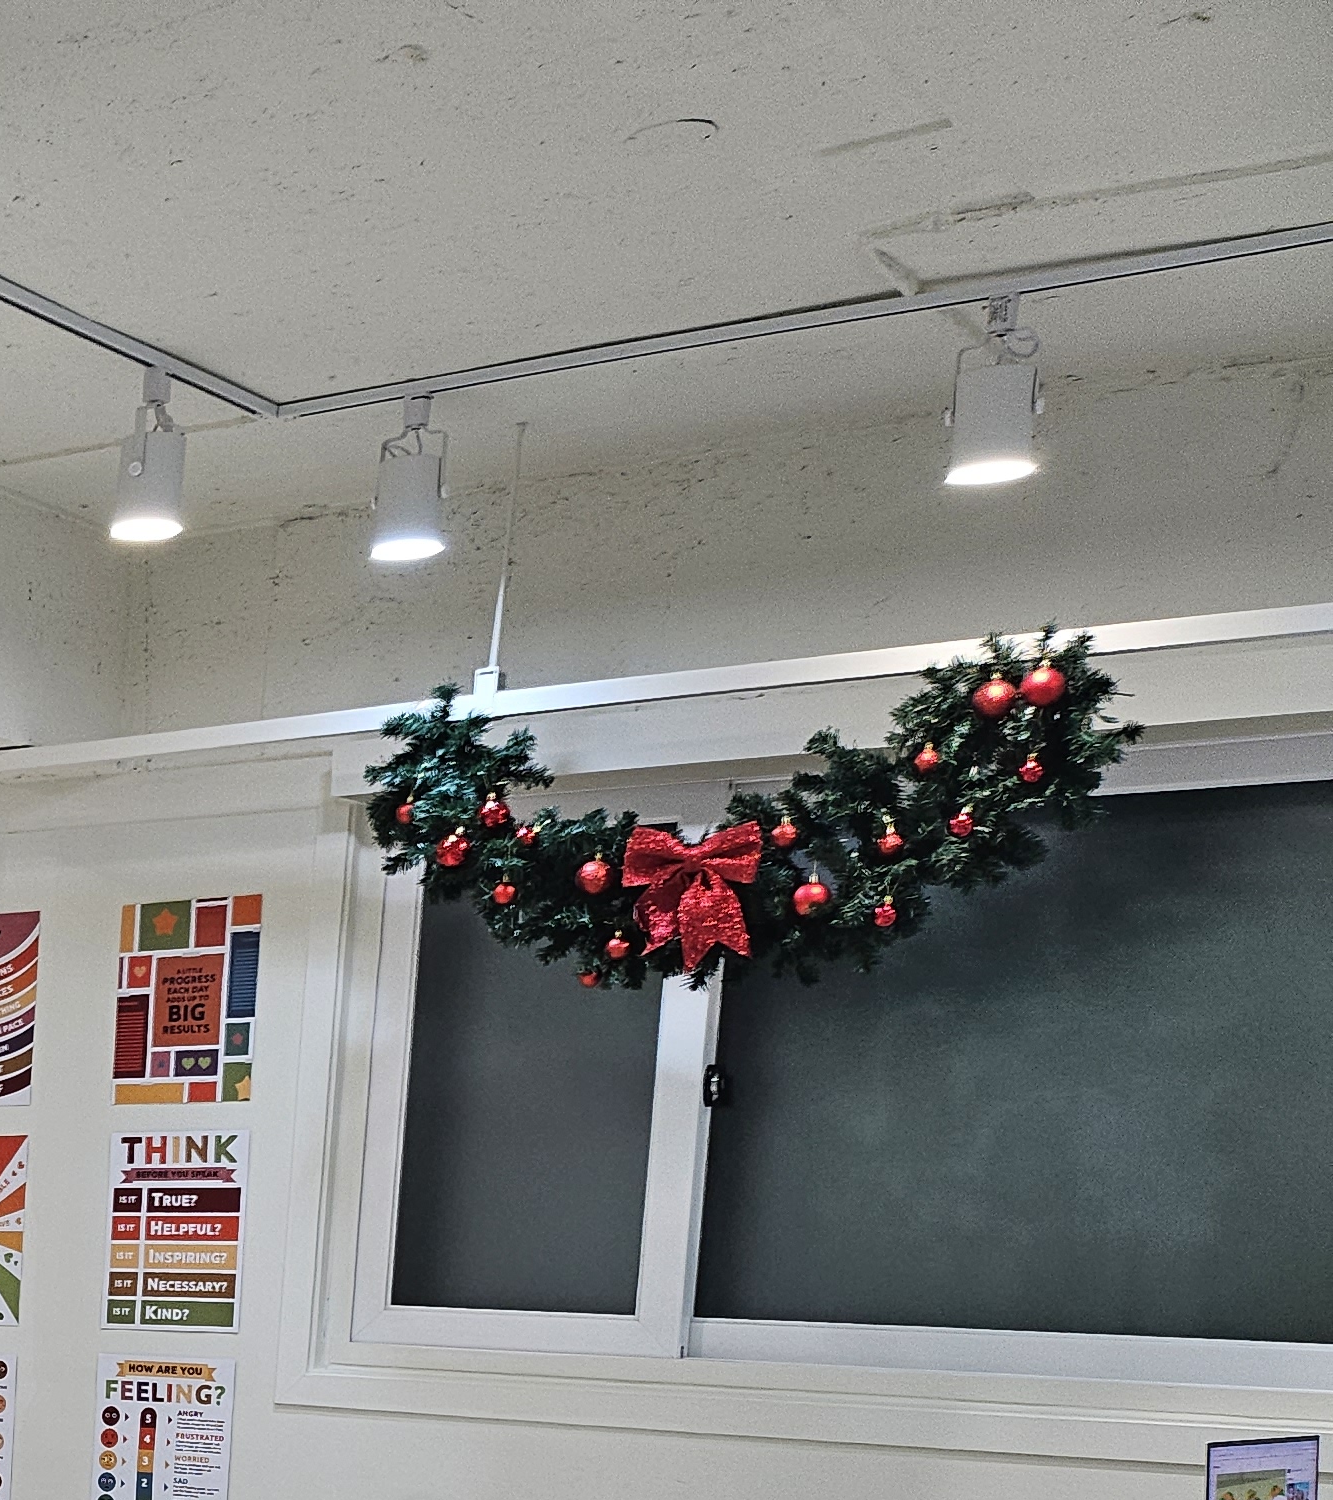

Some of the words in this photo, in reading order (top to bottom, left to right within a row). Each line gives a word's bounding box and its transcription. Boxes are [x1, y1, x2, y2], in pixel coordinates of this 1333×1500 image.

[161, 974, 216, 985] PROGRESS
[167, 986, 190, 995] EACH
[192, 985, 209, 993] DAY
[198, 994, 210, 1002] TO
[168, 1003, 206, 1023] BIG
[3, 1018, 24, 1033] PACE
[162, 1024, 210, 1034] RESULTS
[120, 1134, 238, 1165] THINK
[150, 1220, 222, 1236] HELPFUL?
[147, 1278, 228, 1292] NECESSARY?
[144, 1305, 190, 1321] KIND?
[128, 1364, 154, 1374] HOW
[156, 1365, 178, 1375] ARE
[179, 1366, 203, 1376] YOU
[105, 1379, 226, 1406] FEELING?
[145, 1414, 152, 1424] 5
[176, 1410, 204, 1418] ANGRY
[143, 1435, 151, 1444] 4
[175, 1432, 225, 1442] FRUSTRATED
[141, 1456, 149, 1465] 3
[174, 1455, 210, 1464] WORRIED
[141, 1478, 148, 1487] 2
